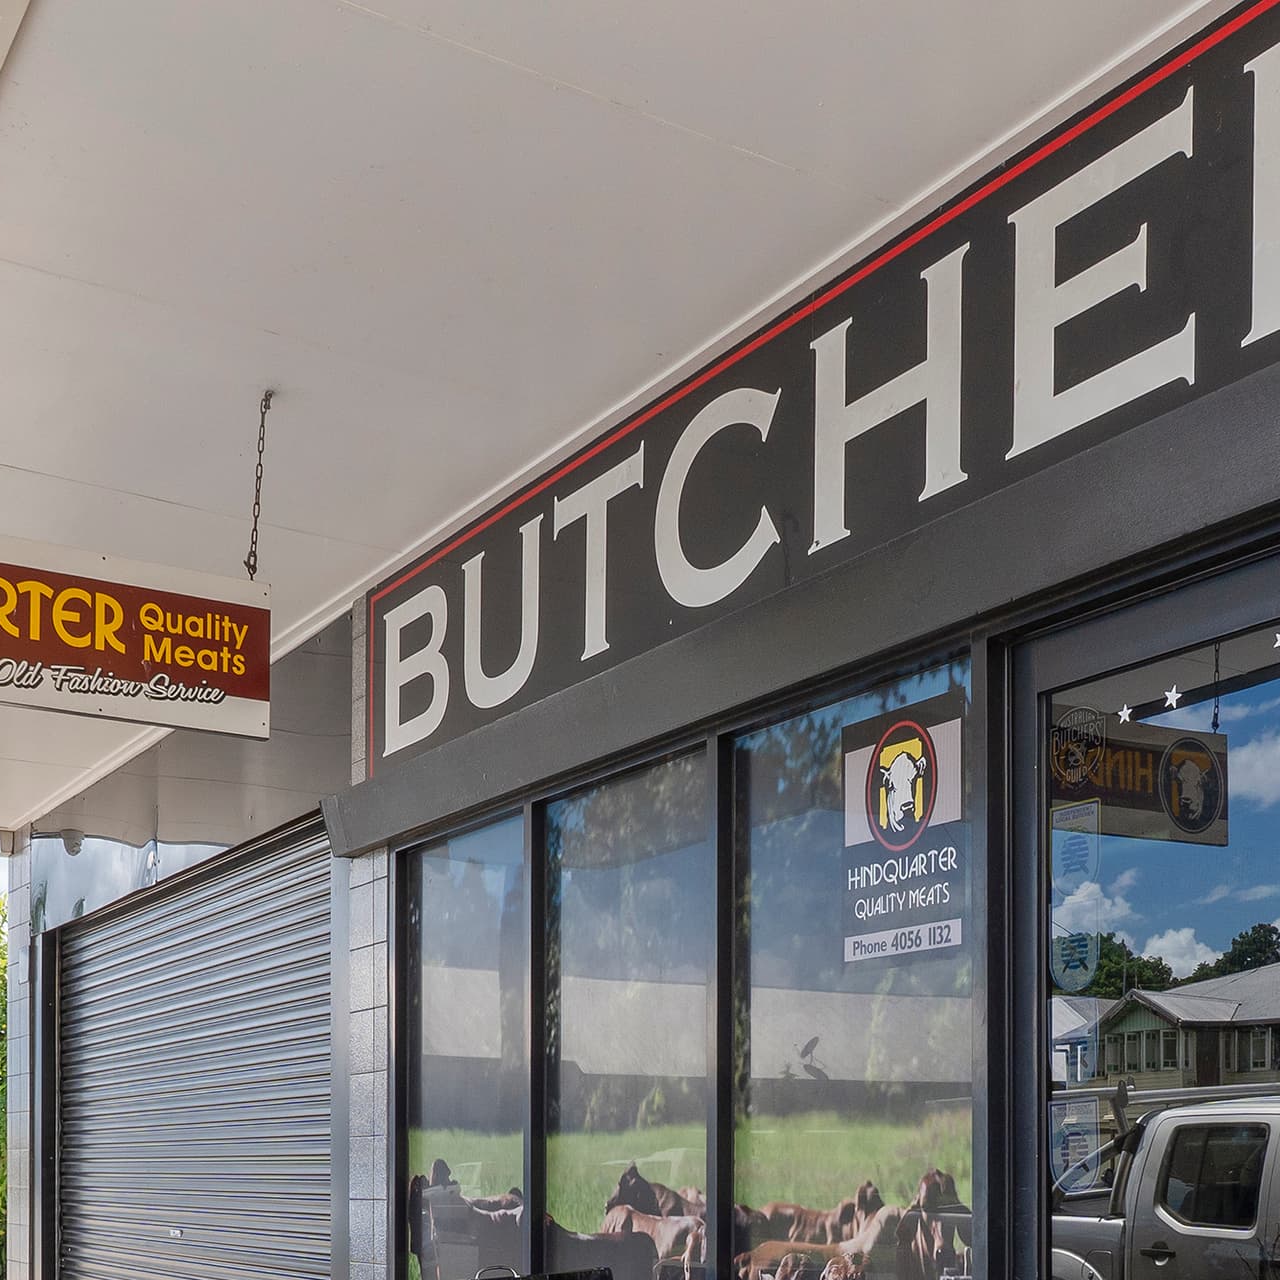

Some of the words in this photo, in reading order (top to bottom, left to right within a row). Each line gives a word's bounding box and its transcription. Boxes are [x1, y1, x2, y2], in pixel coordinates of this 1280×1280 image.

[140, 602, 249, 650] Quality
[144, 633, 246, 676] Meats
[50, 665, 142, 698] Fashion
[145, 673, 226, 704] Service
[848, 846, 958, 890] HINDQUARTER
[855, 891, 906, 920] QUALITY
[909, 882, 950, 909] MEATS
[852, 939, 887, 956] Phone
[891, 929, 922, 951] 4056
[928, 924, 952, 946] 1132
